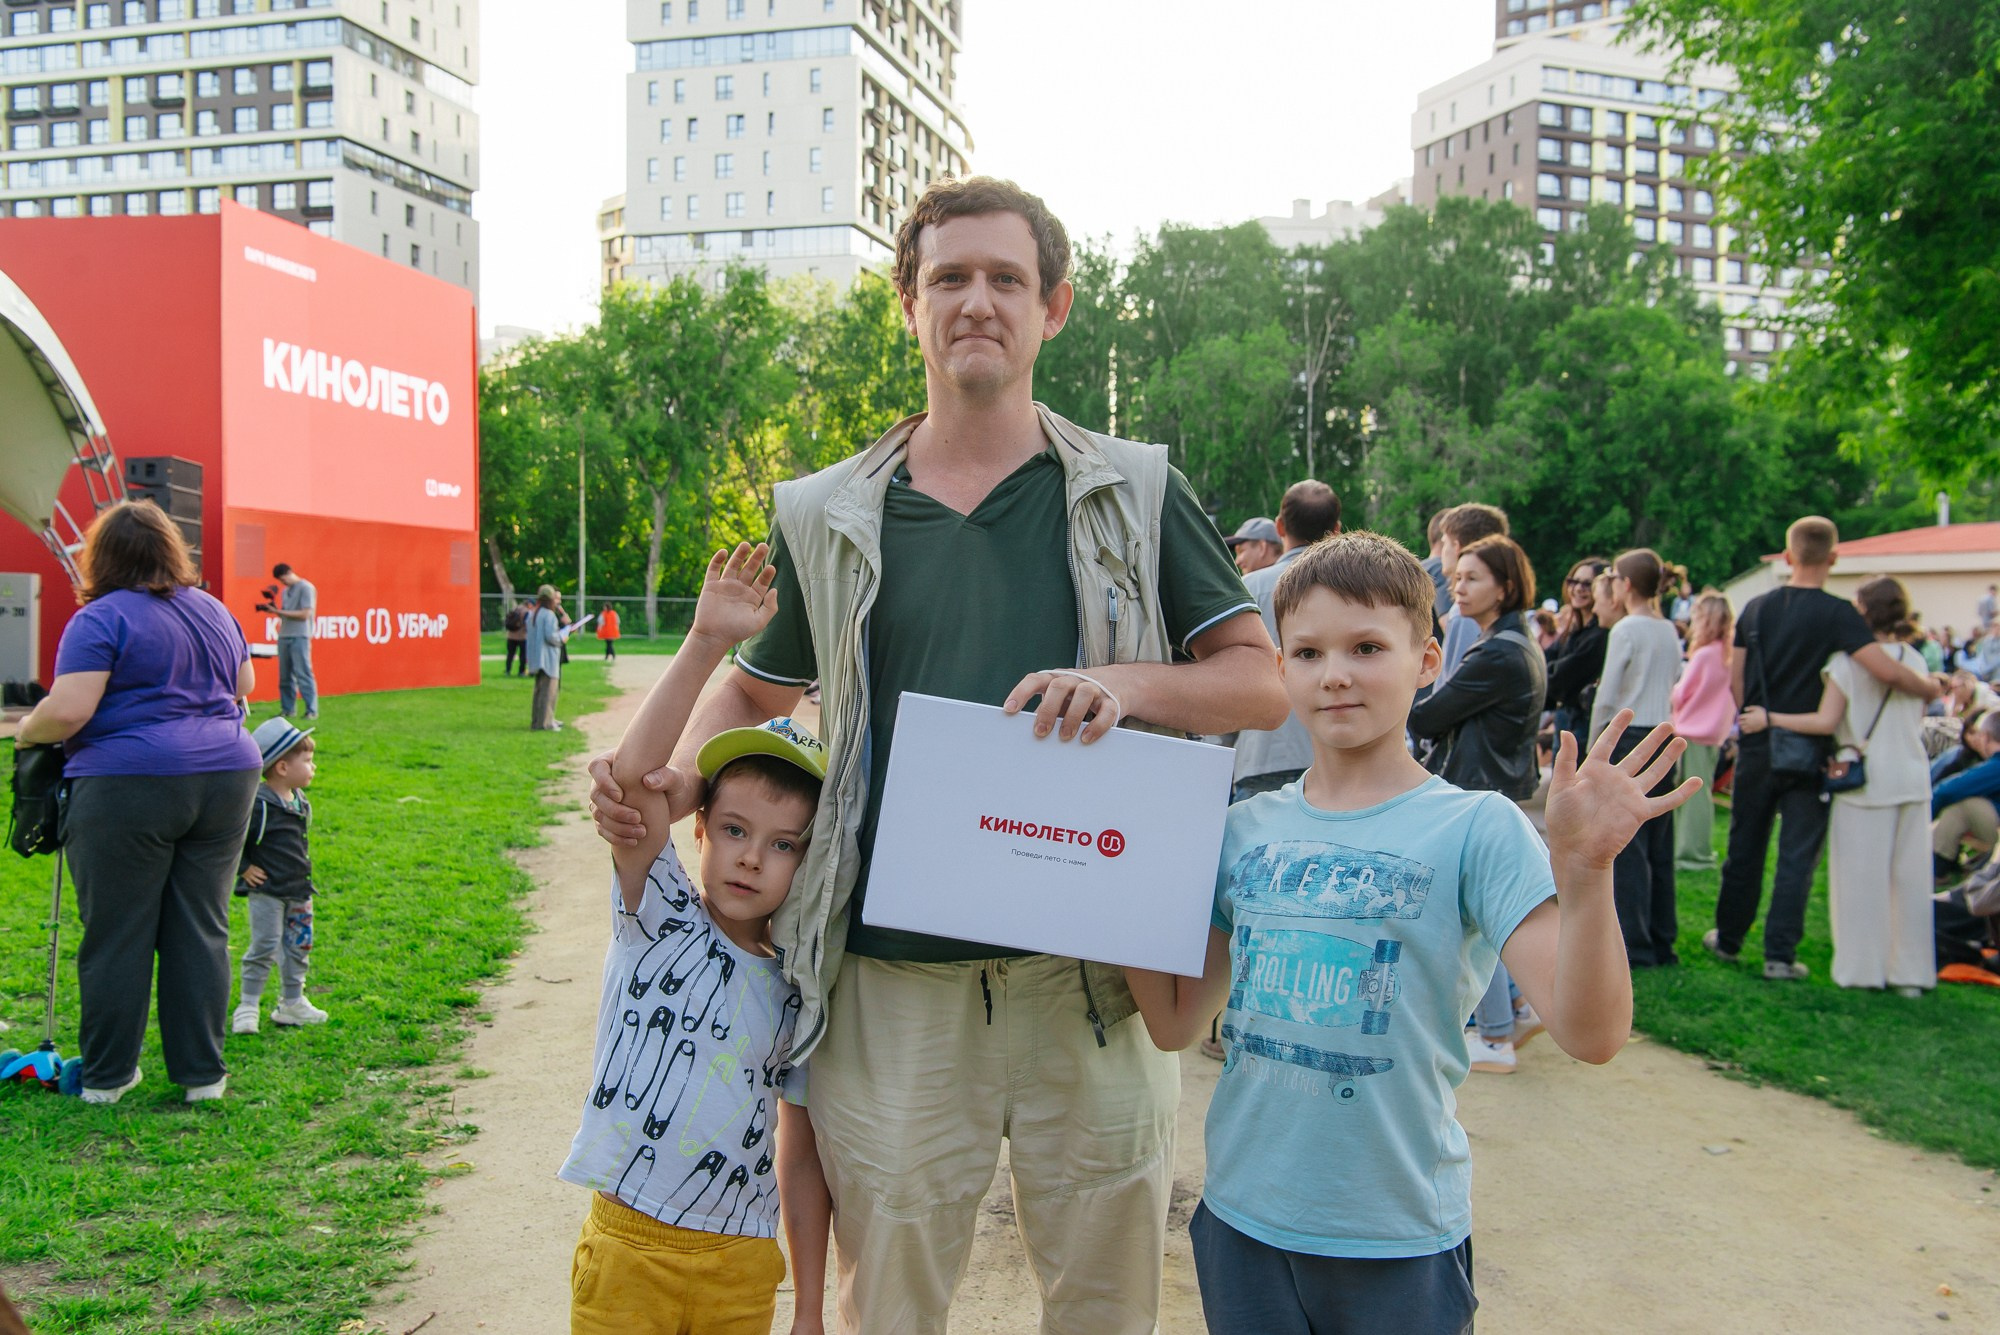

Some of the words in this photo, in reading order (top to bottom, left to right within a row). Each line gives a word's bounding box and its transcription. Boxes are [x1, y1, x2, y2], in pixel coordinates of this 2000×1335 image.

[263, 337, 450, 426] КИНОЛЕТО
[265, 614, 360, 641] КЛЕТО
[397, 612, 449, 639] УБРиР
[979, 815, 1093, 847] КИНОЛЕТО
[1011, 848, 1043, 860] Проведи
[1044, 854, 1061, 863] лето
[1068, 858, 1087, 867] нами
[1267, 859, 1376, 902] KEEP
[1252, 953, 1353, 1005] ROLLING
[1283, 1068, 1320, 1097] LONG
